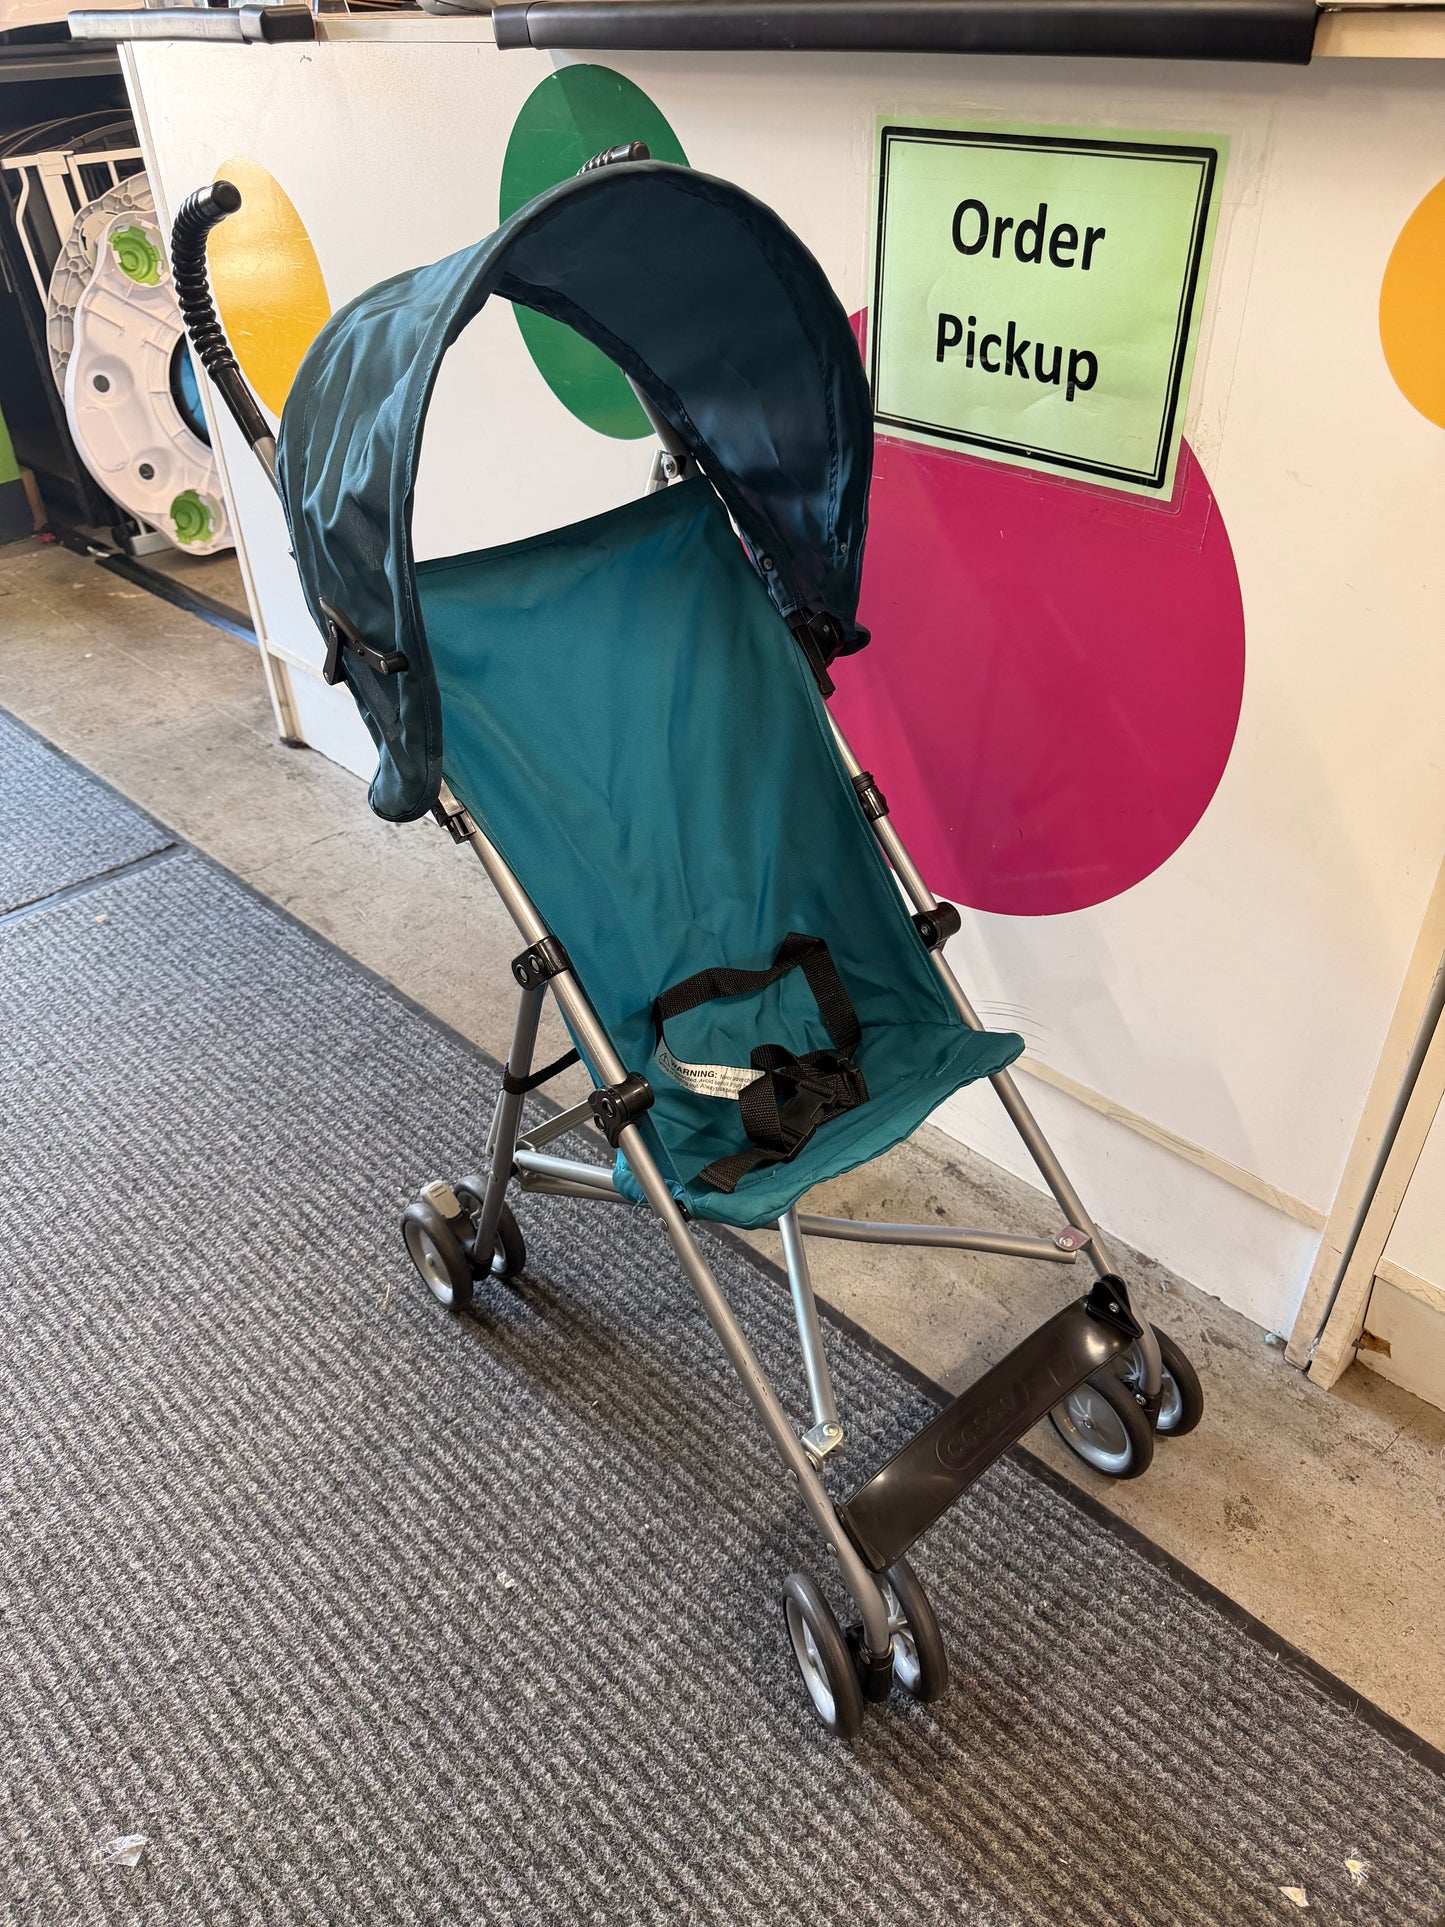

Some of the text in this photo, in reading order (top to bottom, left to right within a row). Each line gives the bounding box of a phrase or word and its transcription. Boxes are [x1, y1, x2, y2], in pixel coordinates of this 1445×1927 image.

[952, 199, 1106, 271] Order
[936, 312, 1099, 402] Pickup
[671, 1061, 718, 1079] WARNING:
